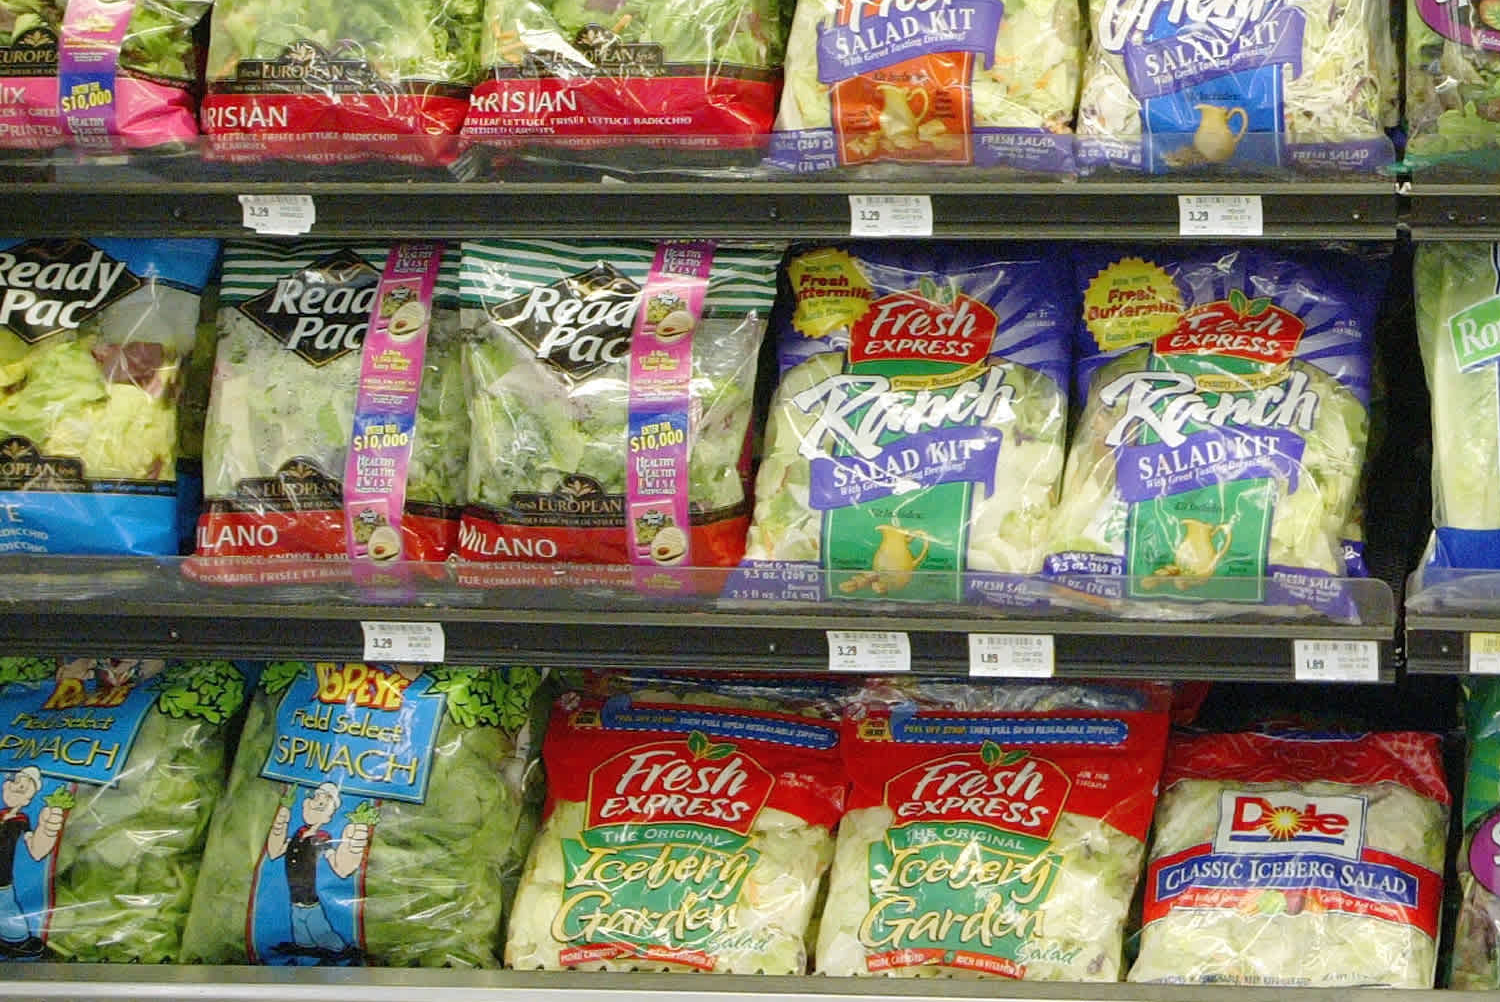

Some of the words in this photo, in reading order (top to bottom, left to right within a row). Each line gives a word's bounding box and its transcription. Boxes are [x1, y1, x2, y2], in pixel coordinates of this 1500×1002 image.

[836, 20, 923, 57] SALAD
[930, 6, 976, 34] KIT
[800, 274, 848, 289] Fresh
[1108, 288, 1158, 304] Fresh
[2, 290, 85, 329] Pac
[869, 300, 977, 341] Fresh
[865, 337, 974, 359] EXPRESS
[1170, 333, 1280, 356] EXPRESS
[791, 364, 1015, 457] Ranch
[1103, 371, 1319, 448] Ranch
[353, 433, 409, 452] $10,000
[630, 429, 684, 453] $10,000
[1139, 440, 1224, 479] SALAD
[1235, 436, 1280, 459] KIT
[538, 499, 622, 514] EUROPEAN
[458, 523, 558, 559] MILANO
[275, 735, 418, 786] SPINACH
[616, 750, 749, 796] Fresh
[912, 760, 1043, 800] Fresh
[600, 795, 750, 822] EXPRESS
[898, 797, 1050, 828] EXPRESS
[603, 829, 640, 844] THE
[644, 827, 723, 846] ORIGINAL
[906, 827, 936, 844] THE
[940, 830, 1026, 851] ORIGINAL
[567, 840, 751, 901] Iceberg
[883, 845, 1052, 903] Iceberg
[1166, 859, 1245, 891] CLASSIC
[1250, 857, 1335, 881] ICEBERG
[1340, 863, 1408, 895] SALAD
[551, 888, 739, 945] Garden
[860, 892, 1045, 949] Garden
